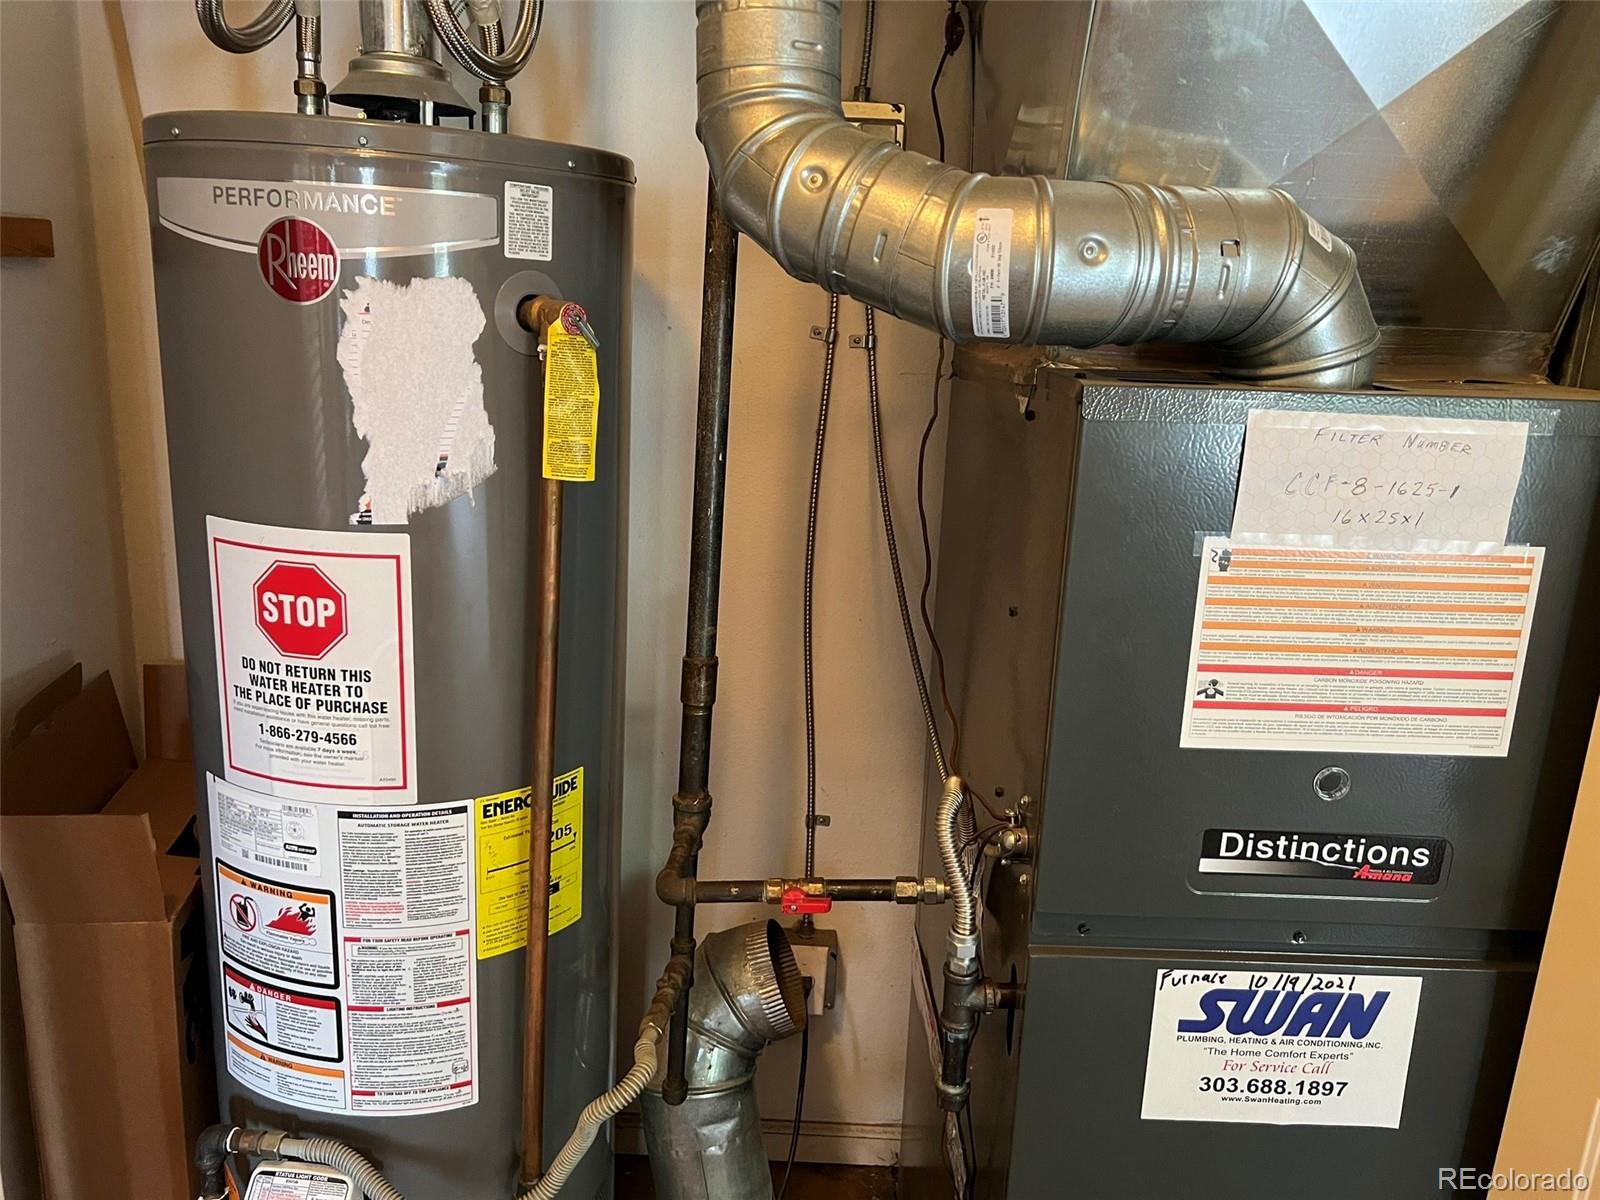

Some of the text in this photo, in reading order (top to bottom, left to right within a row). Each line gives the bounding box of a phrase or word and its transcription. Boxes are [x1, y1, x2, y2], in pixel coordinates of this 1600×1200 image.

[266, 219, 335, 291] Rheem
[1313, 427, 1384, 447] FILTER
[262, 591, 336, 628] STOP
[241, 656, 372, 683] DO NOT RETURN THIS
[249, 673, 363, 698] WATER HEATER TO
[233, 684, 388, 714] THE PLACE OF PURCHASE
[258, 722, 357, 746] 1-866-279-4566
[482, 792, 532, 819] ENERG
[552, 775, 578, 800] UIDE
[1219, 831, 1431, 867] Distinctions
[1353, 864, 1413, 882] Amana
[250, 881, 293, 899] WARNING
[258, 940, 281, 950] EXPLOSION
[281, 947, 300, 955] HAZARD
[255, 985, 292, 1001] DANGER
[1177, 988, 1391, 1040] SWAN
[1176, 1035, 1227, 1045] PLUMBING,
[1229, 1036, 1269, 1045] HEATING
[1270, 1038, 1277, 1046] &
[1279, 1038, 1295, 1046] AIR
[1230, 1048, 1262, 1057] Home
[1265, 1049, 1307, 1059] Comfort
[1222, 1059, 1334, 1075] For Service Call
[1198, 1076, 1350, 1097] 303.688.1897
[1221, 1095, 1322, 1106] www.SwanHeating.com
